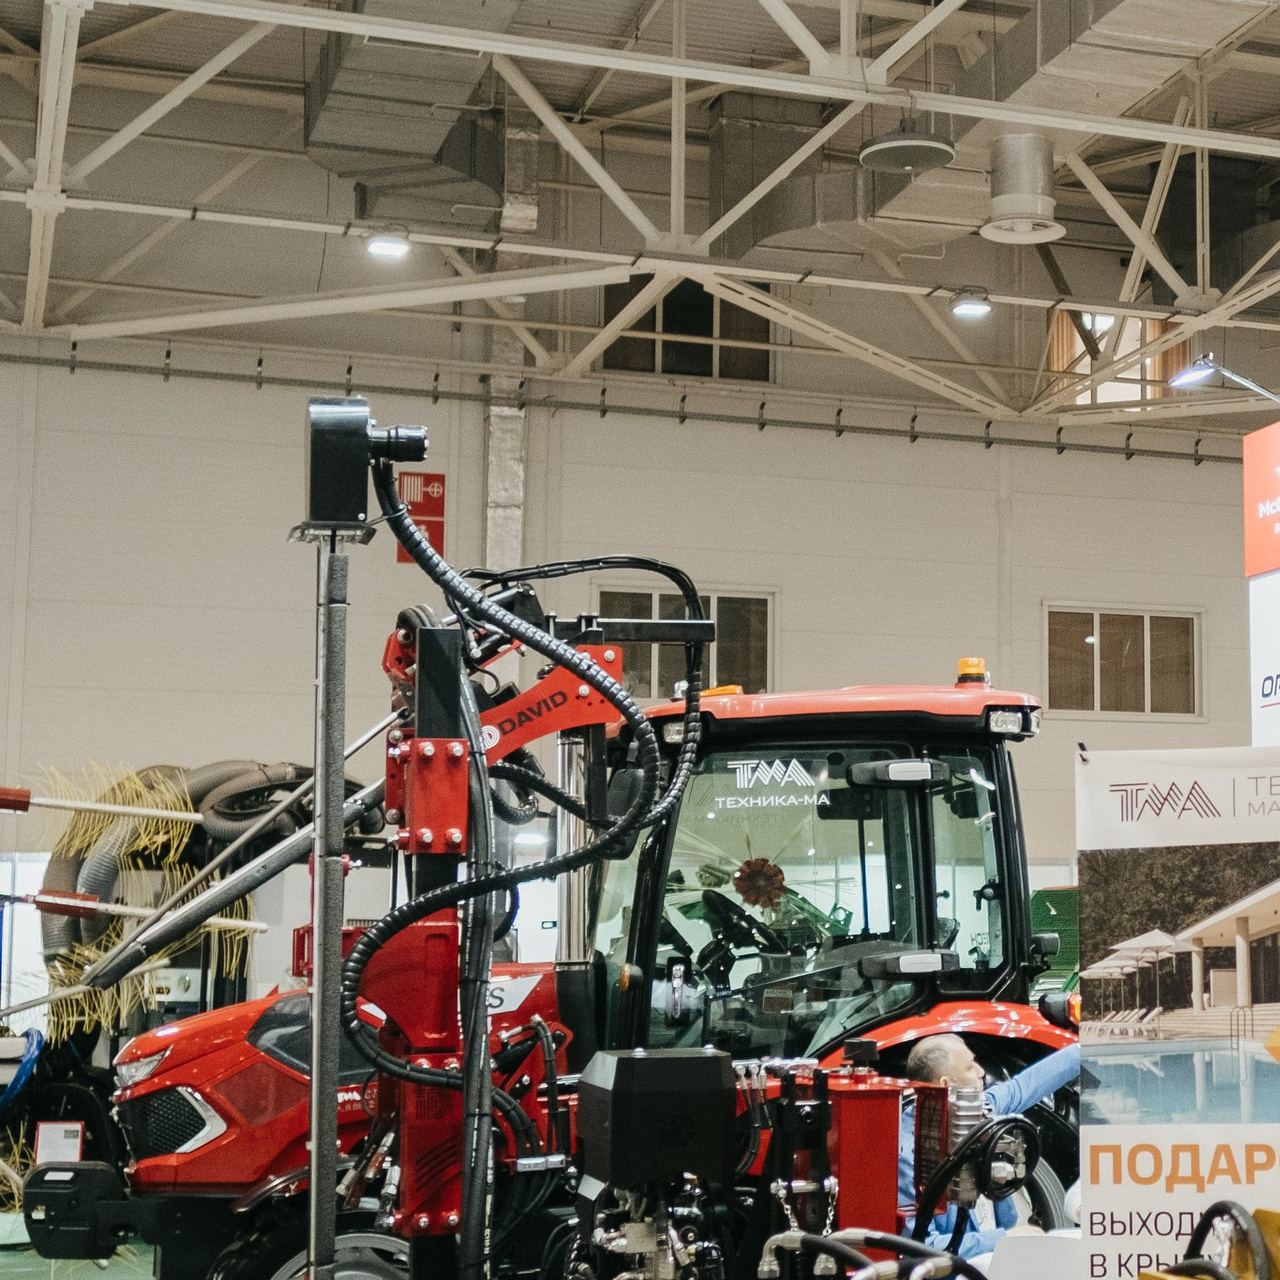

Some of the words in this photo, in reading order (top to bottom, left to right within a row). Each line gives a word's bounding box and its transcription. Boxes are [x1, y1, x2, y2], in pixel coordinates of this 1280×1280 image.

[497, 690, 568, 736] DAVID
[714, 794, 832, 809] ТЕХНИКА-МА
[1089, 1211, 1203, 1241] ВЫХОД
[1090, 1253, 1107, 1278] В
